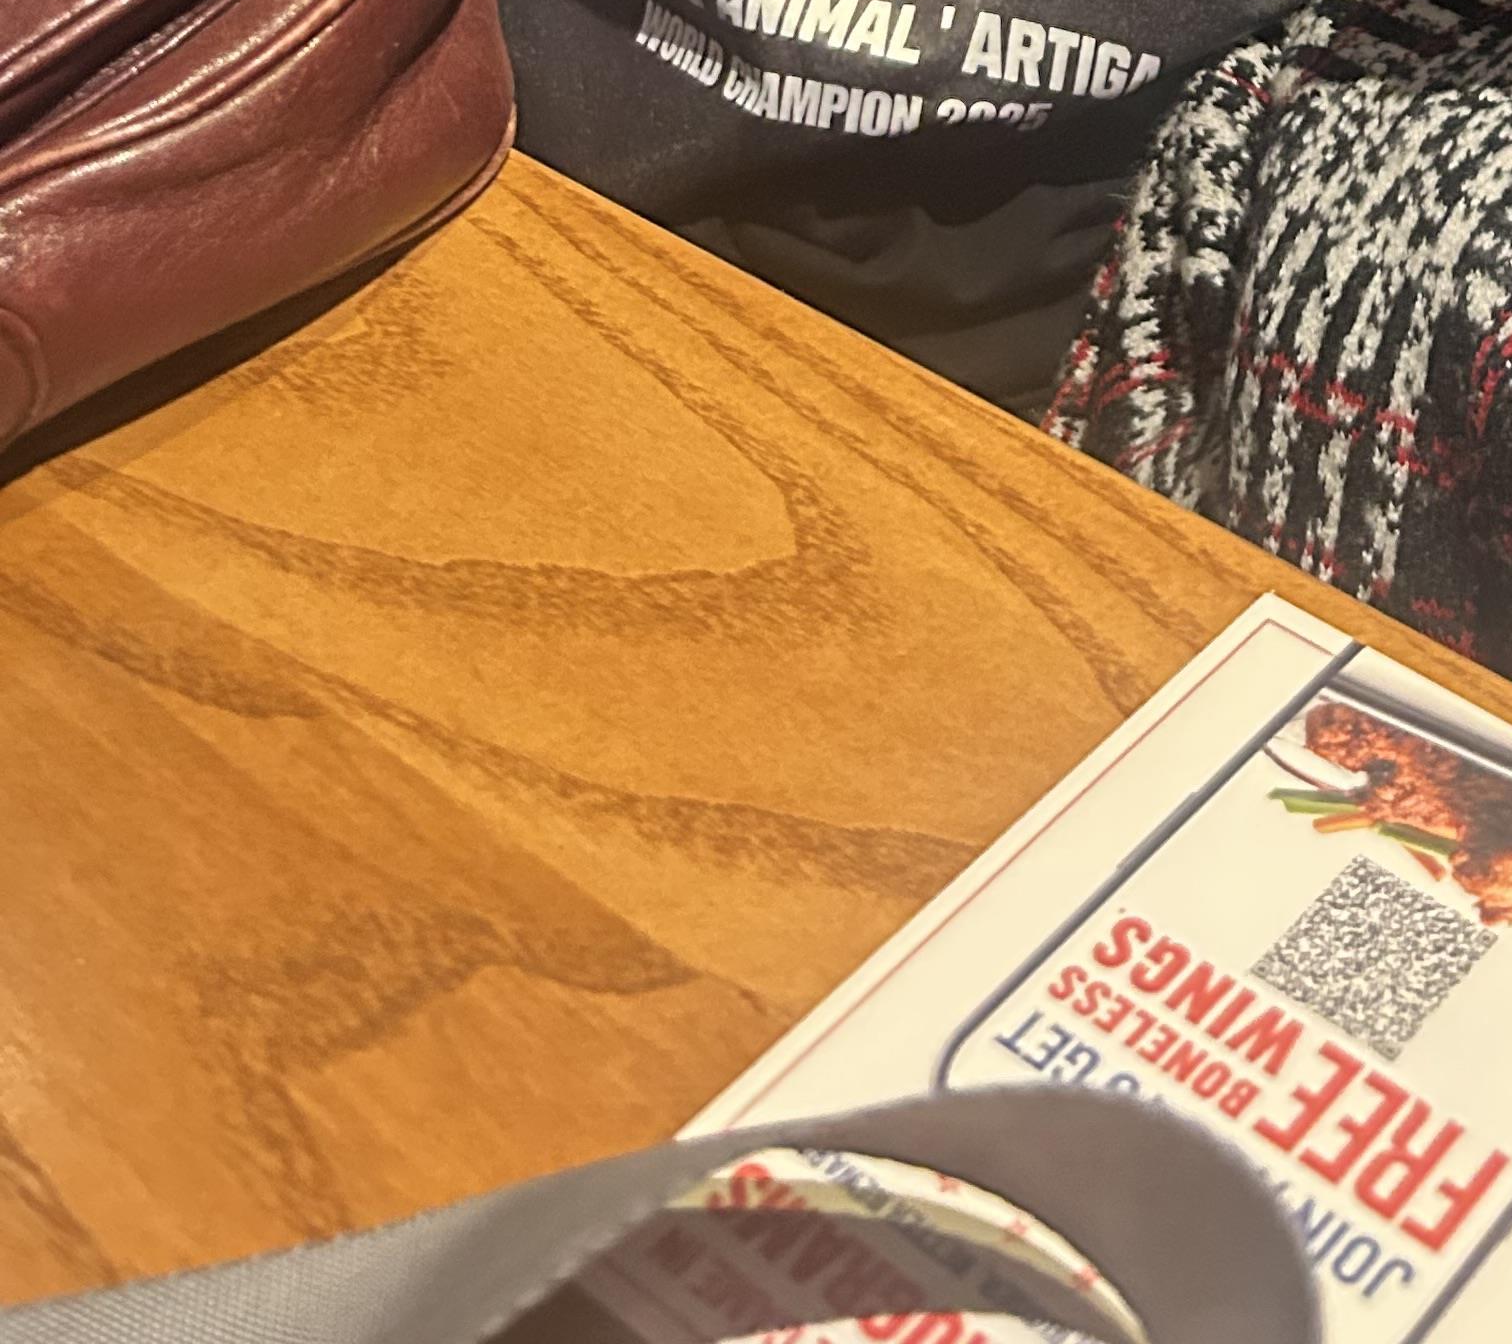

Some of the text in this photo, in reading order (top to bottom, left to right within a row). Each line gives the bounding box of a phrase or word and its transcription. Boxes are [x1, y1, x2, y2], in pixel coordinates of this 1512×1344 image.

[722, 55, 924, 138] CHAMPION
[961, 10, 1161, 100] ARTIGA
[994, 1009, 1103, 1087] GET
[1047, 964, 1512, 1254] FREE BONELESS
[1297, 1197, 1417, 1299] JOIN
